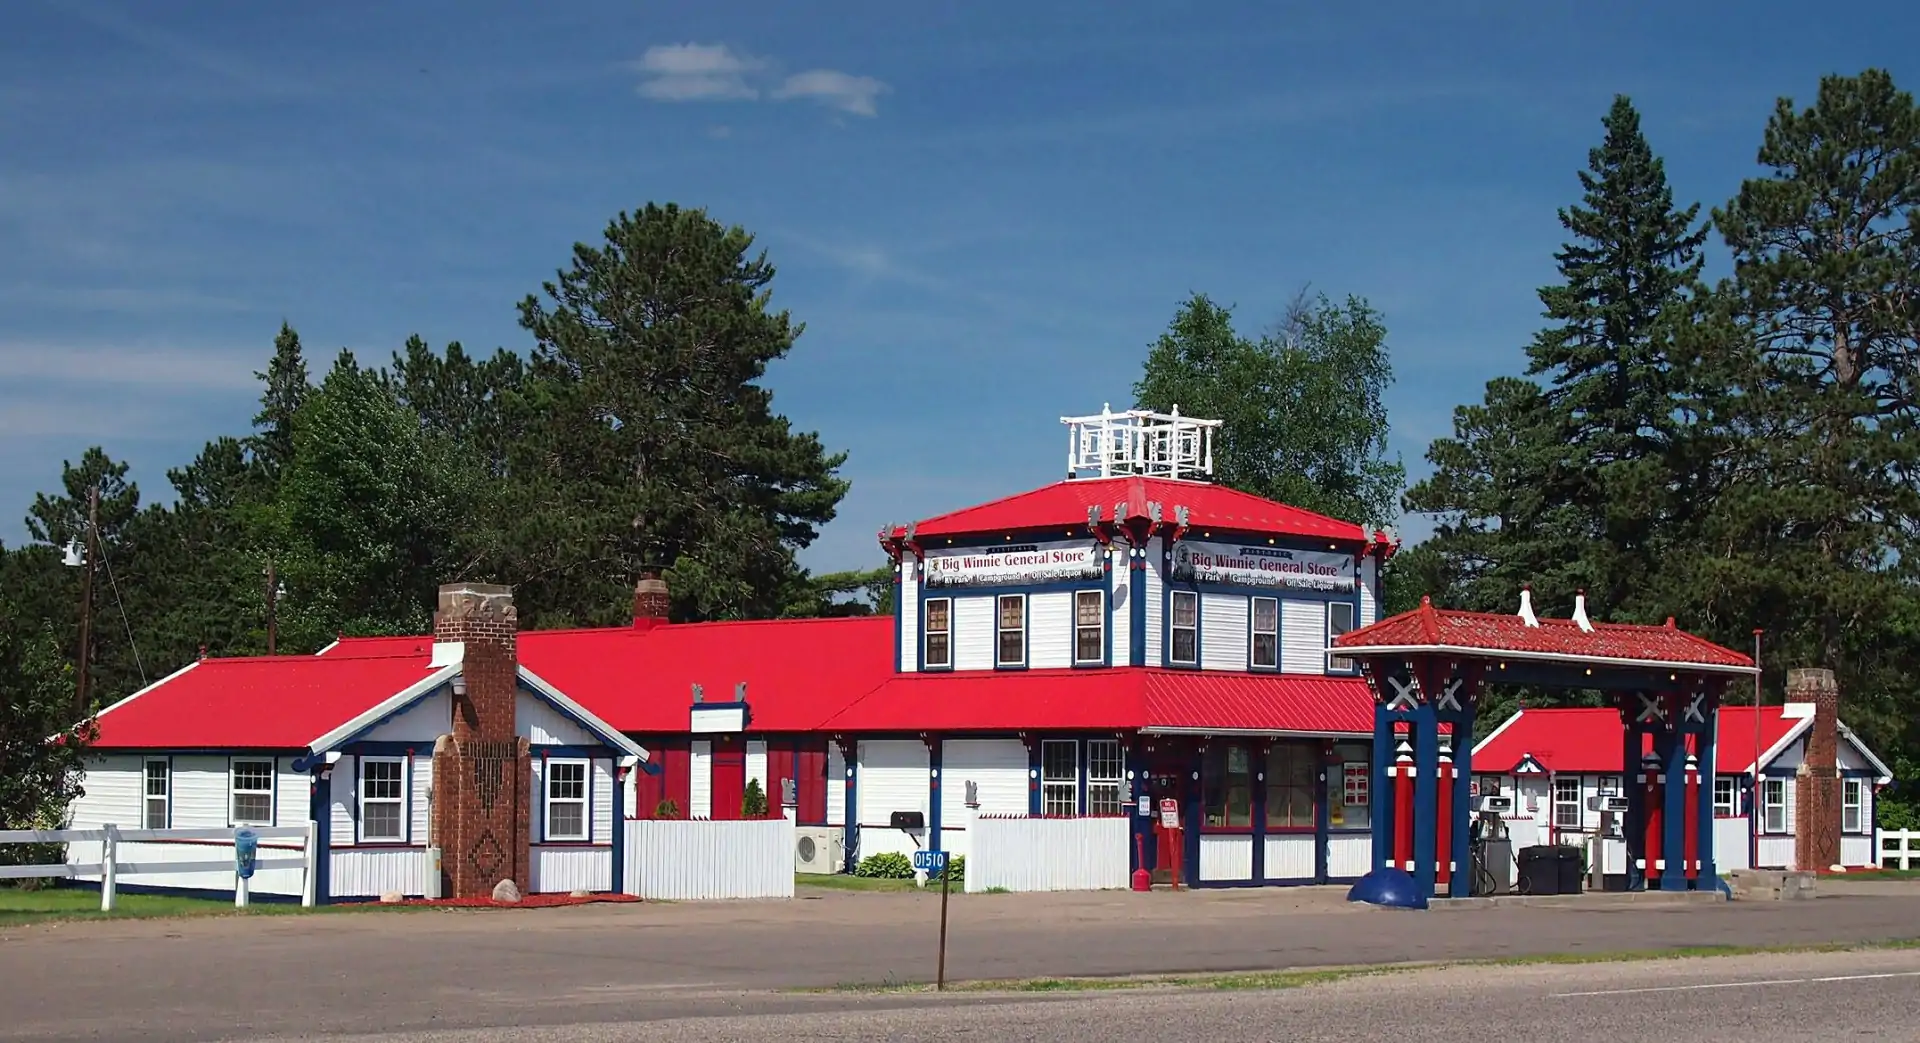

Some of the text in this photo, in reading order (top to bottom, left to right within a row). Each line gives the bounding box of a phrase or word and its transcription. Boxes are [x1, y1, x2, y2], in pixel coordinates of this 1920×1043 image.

[942, 550, 1085, 572] Big Winnie General Store
[1192, 552, 1337, 577] Big Winnie General Store
[954, 575, 969, 583] Park
[979, 572, 1021, 583] Campground
[1059, 568, 1081, 579] Liquor
[1205, 571, 1221, 581] Park
[1232, 574, 1275, 585] Campground
[1286, 578, 1297, 587] Off
[1297, 578, 1311, 588] Sale
[1313, 580, 1334, 591] Liquor
[915, 852, 944, 867] 01510
